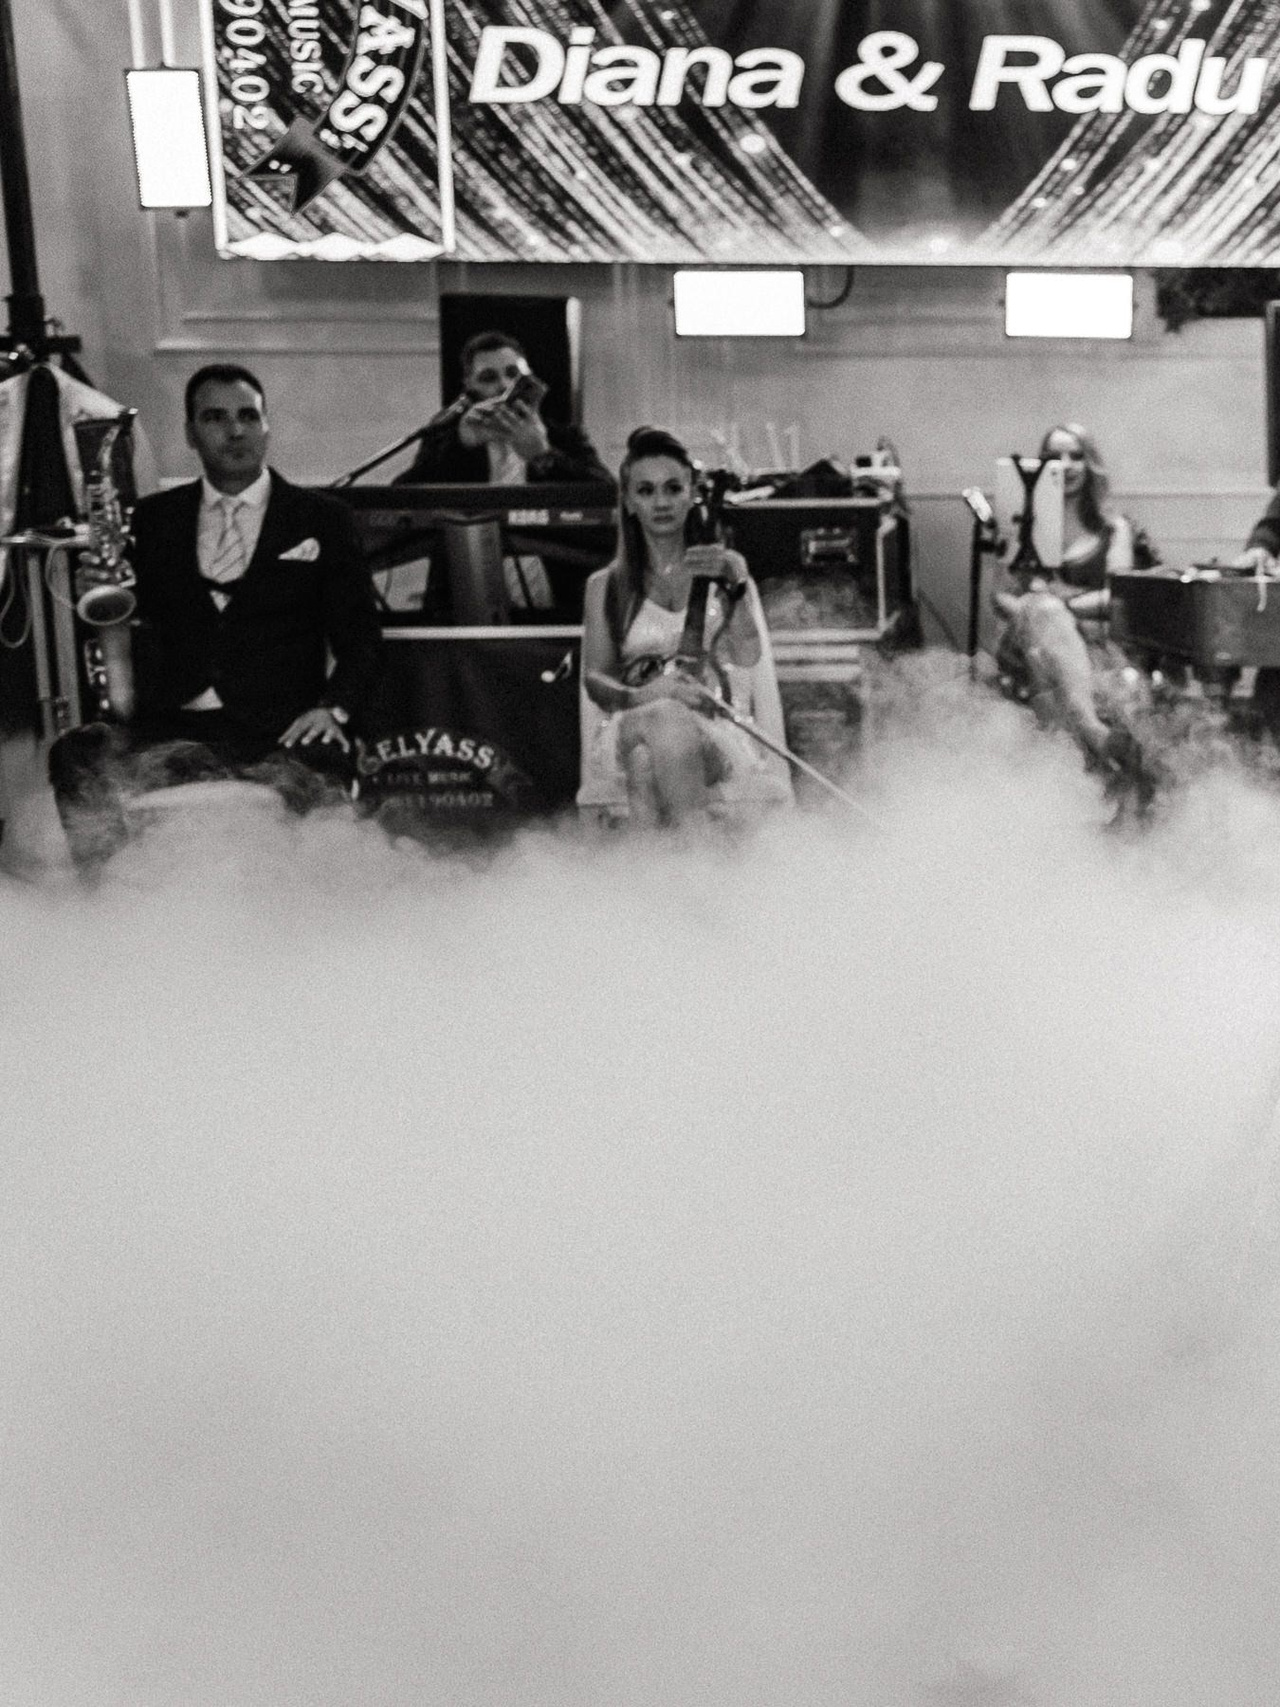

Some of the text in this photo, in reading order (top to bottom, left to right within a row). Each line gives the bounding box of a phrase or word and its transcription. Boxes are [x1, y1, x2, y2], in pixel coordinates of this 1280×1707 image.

[468, 26, 805, 107] Diana
[833, 29, 945, 112] &
[969, 33, 1269, 116] Radu
